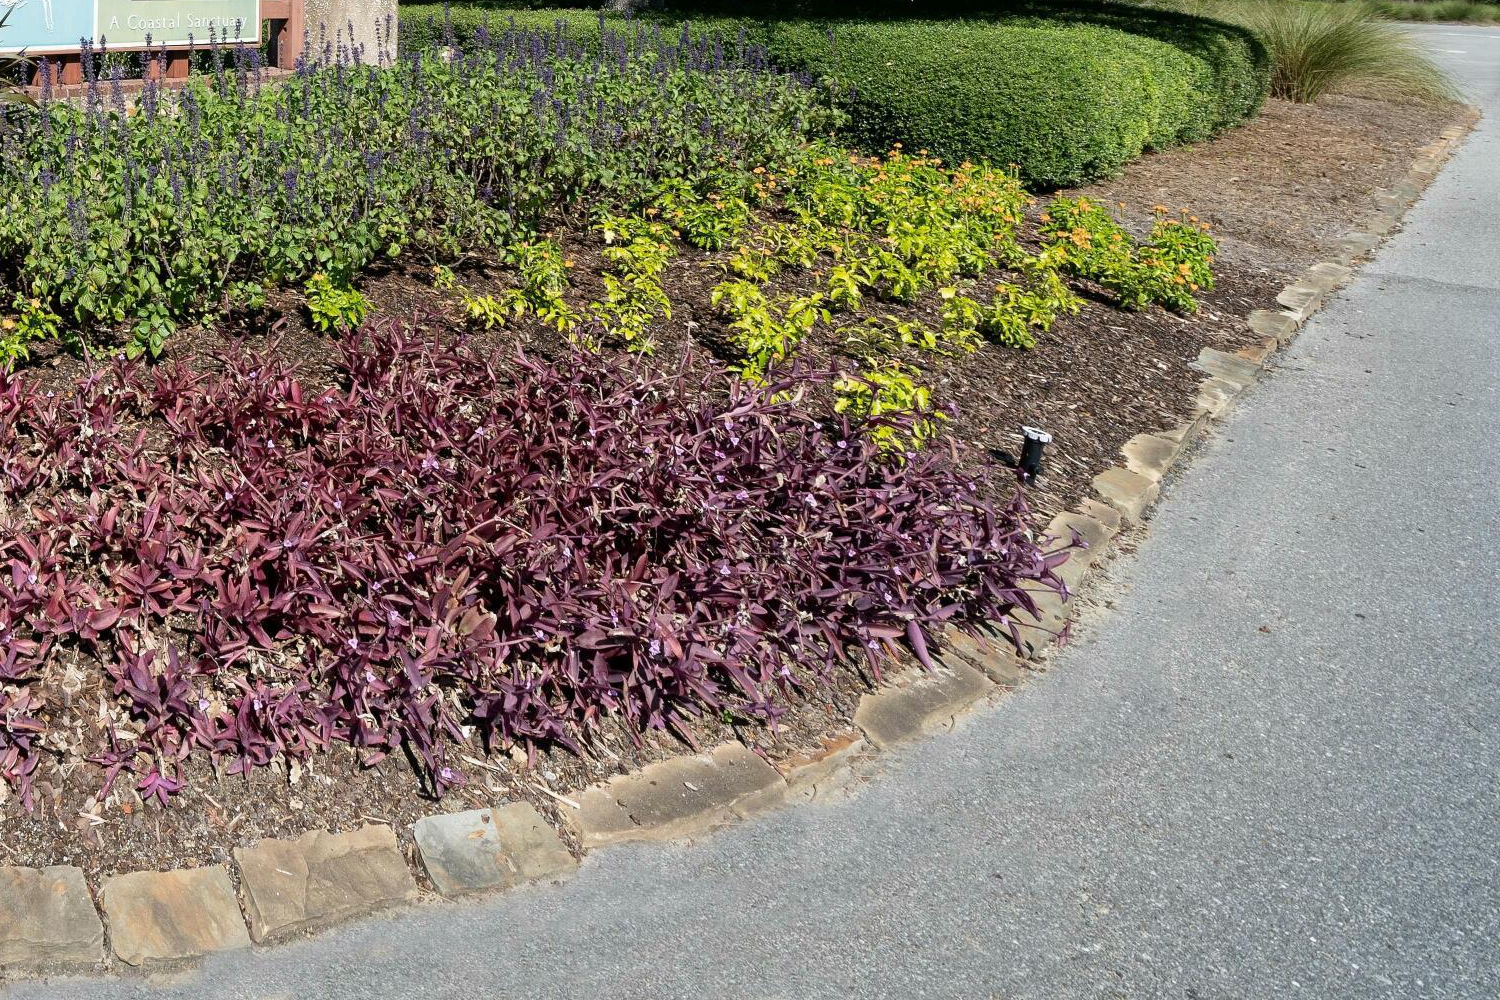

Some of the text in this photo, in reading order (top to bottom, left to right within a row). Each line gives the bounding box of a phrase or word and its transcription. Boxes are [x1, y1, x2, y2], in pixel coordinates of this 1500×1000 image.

[109, 11, 247, 30] A Coastal Sanctuay
